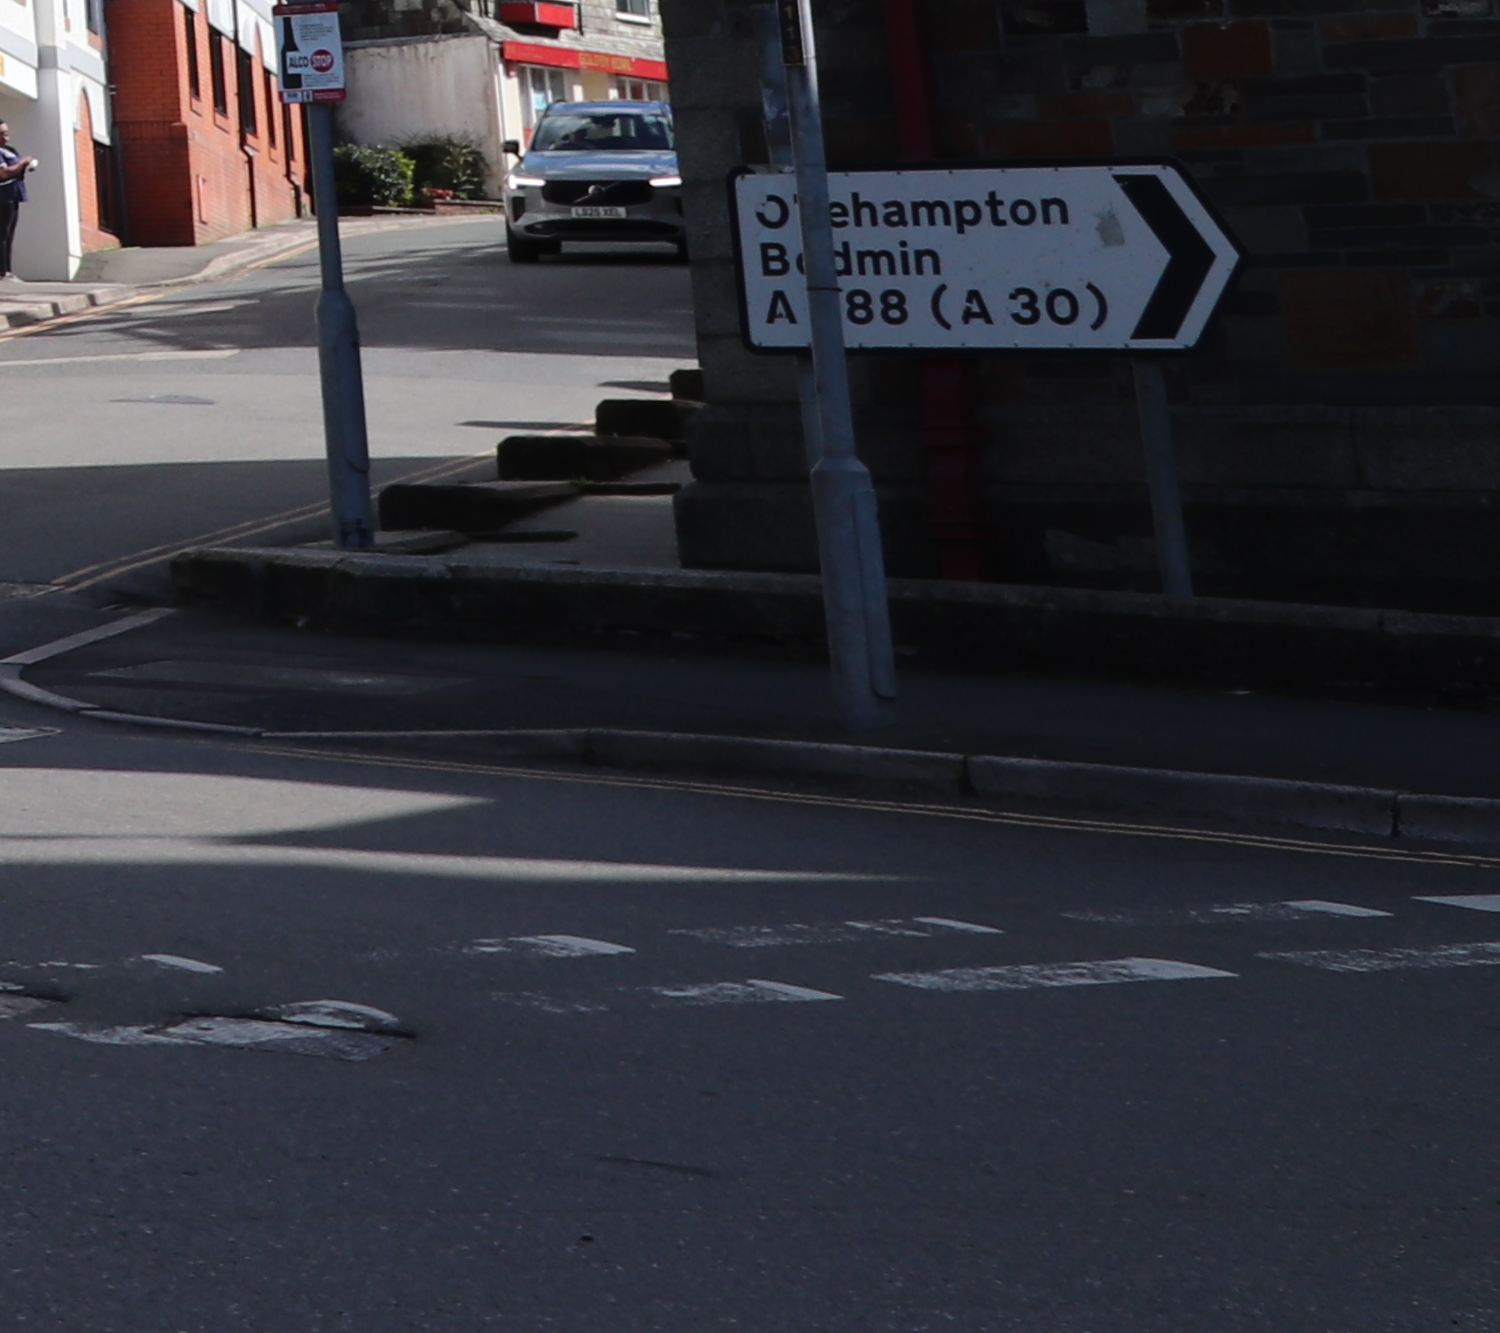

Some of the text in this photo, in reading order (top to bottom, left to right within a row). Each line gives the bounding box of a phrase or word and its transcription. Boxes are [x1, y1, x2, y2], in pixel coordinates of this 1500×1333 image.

[289, 54, 333, 69] ALCO STOP
[756, 191, 1070, 234] Oehampton
[760, 240, 941, 277] Bdmin
[766, 289, 909, 325] A88
